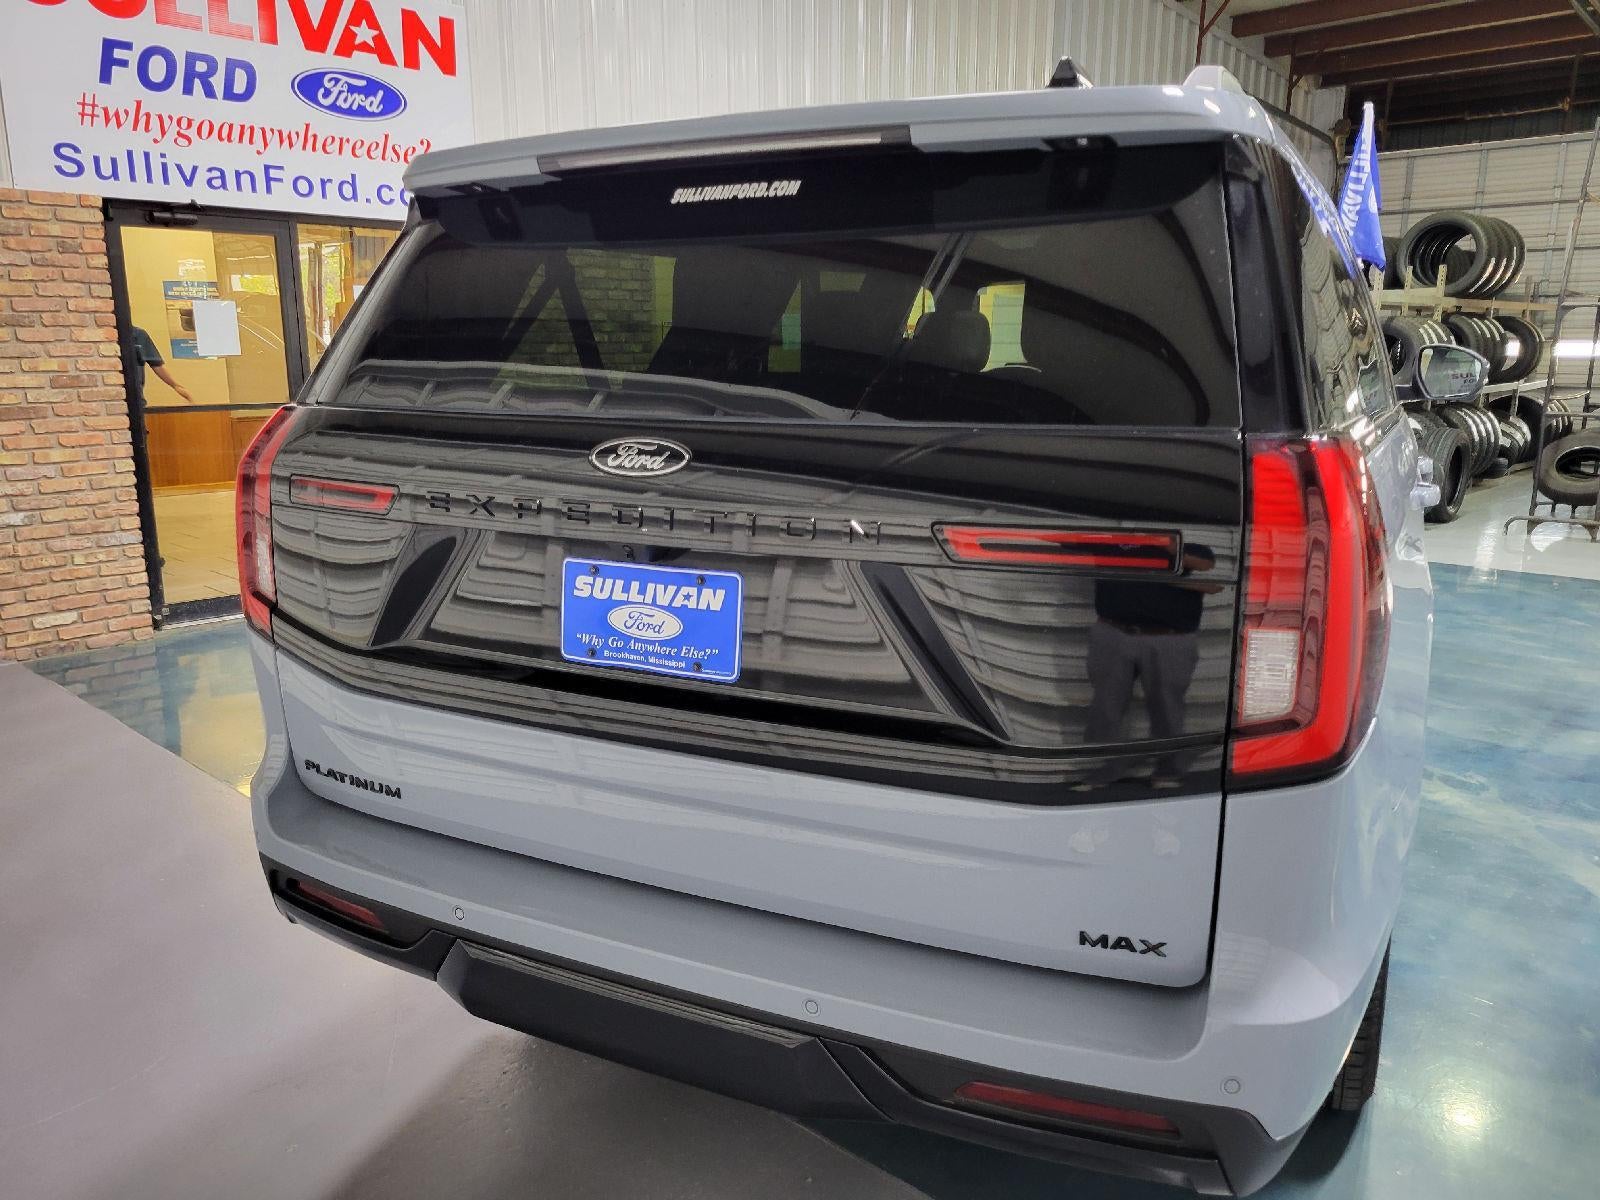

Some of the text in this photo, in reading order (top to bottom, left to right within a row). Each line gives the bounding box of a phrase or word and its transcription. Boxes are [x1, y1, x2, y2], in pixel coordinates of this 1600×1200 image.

[98, 36, 258, 103] FORD
[316, 73, 384, 113] Ford
[76, 91, 432, 165] #whygoanywhereelse?
[670, 180, 802, 205] SULLIVANFORD.COM
[607, 443, 671, 470] Ford
[424, 490, 882, 546] EXPEDITION
[573, 575, 726, 612] SULLIVAN
[623, 610, 666, 636] Ford
[608, 636, 625, 649] Go
[626, 638, 678, 657] Anywhere
[648, 655, 687, 669] Mississippi
[304, 759, 402, 800] PLATINUM
[1079, 930, 1168, 958] MAX
